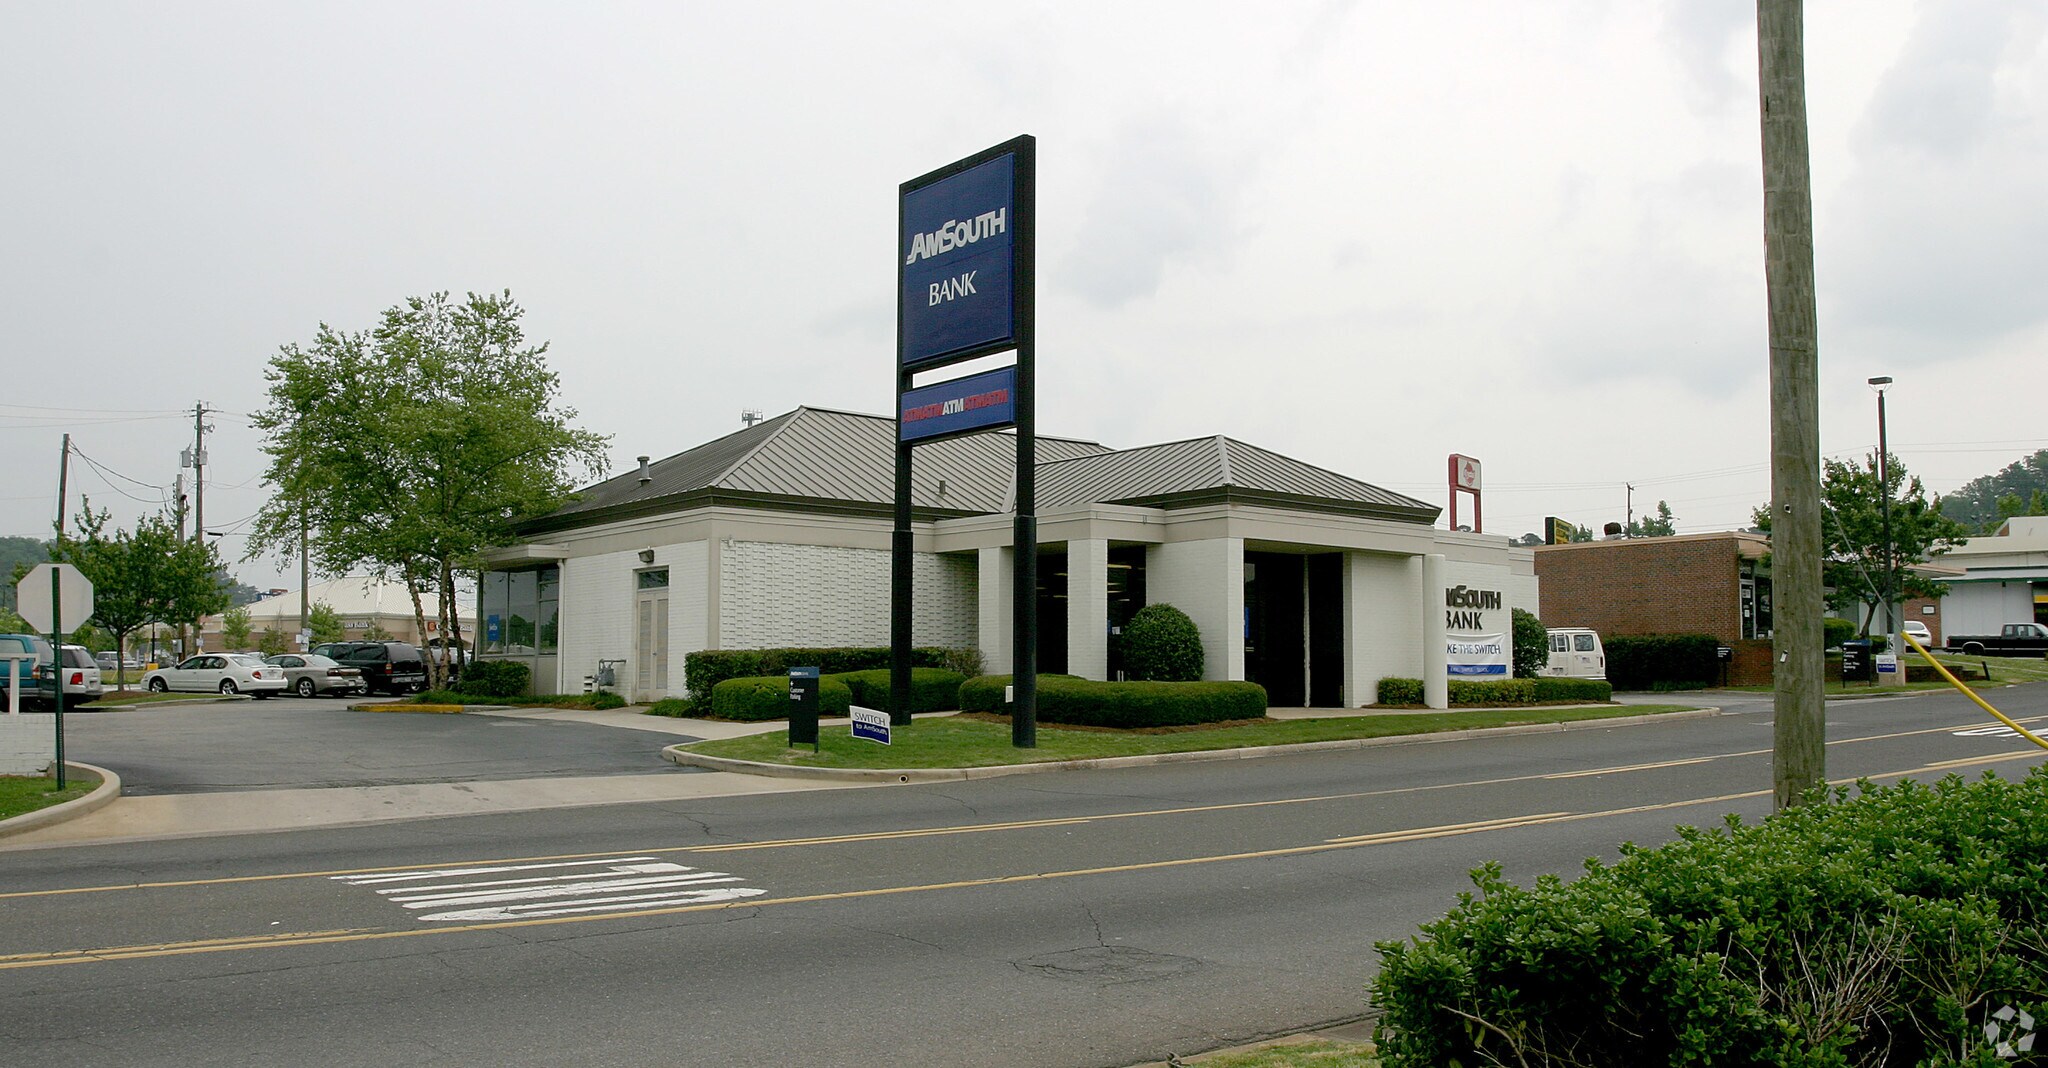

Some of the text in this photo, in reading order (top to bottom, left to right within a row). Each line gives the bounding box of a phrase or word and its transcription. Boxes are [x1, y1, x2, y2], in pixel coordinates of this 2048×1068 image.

[928, 270, 977, 307] BANK
[1447, 644, 1457, 654] KE
[1459, 644, 1473, 654] THE
[855, 712, 885, 726] SWITCH
[864, 724, 888, 735] AmSouth
